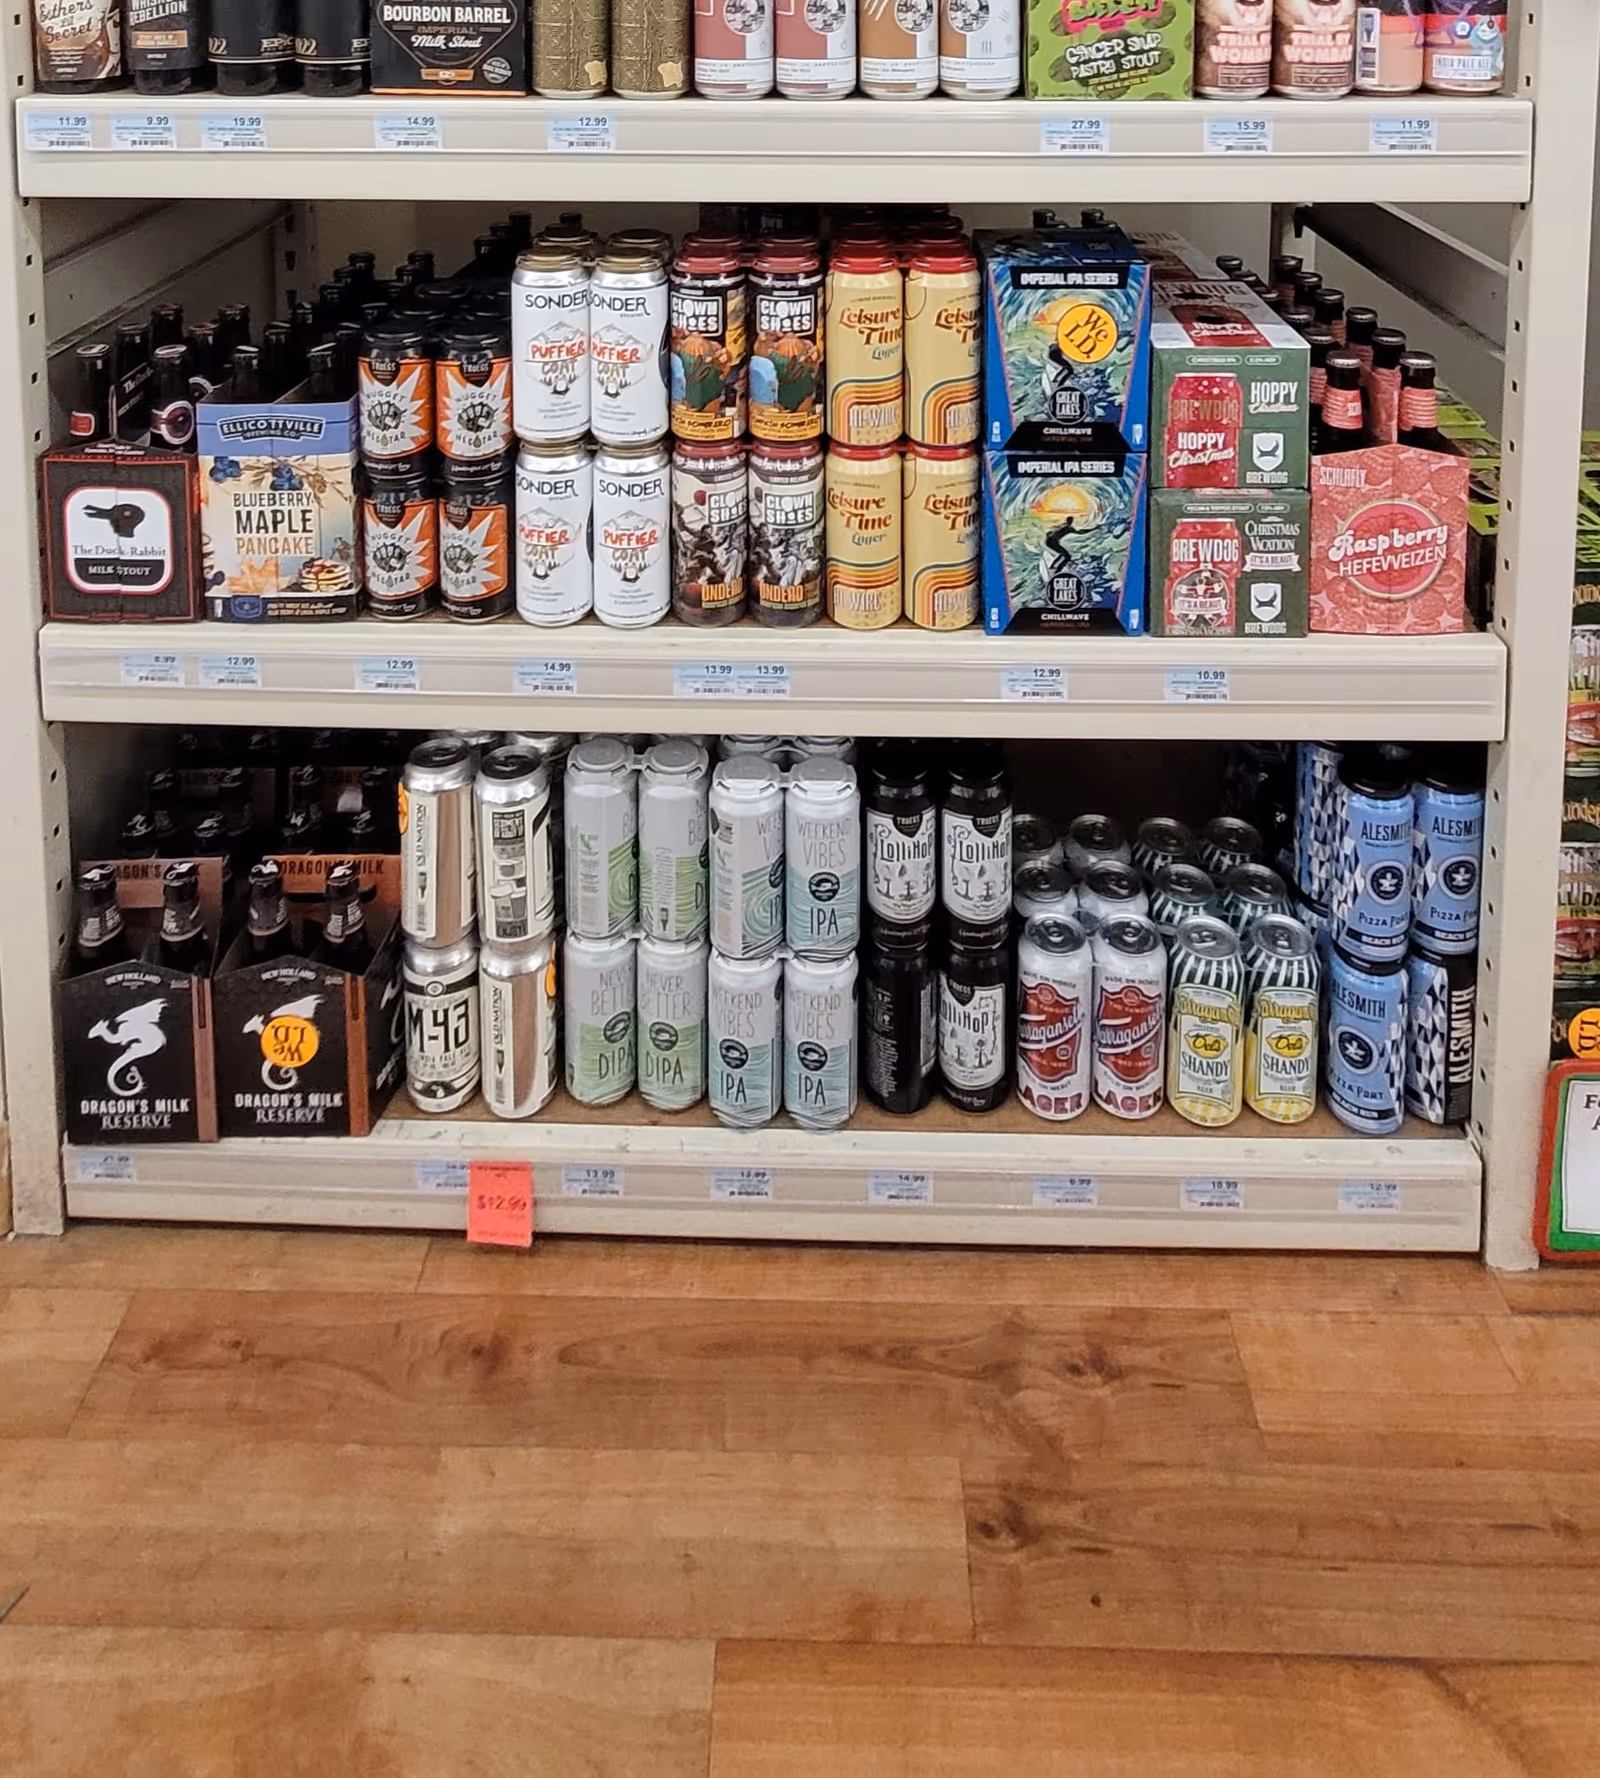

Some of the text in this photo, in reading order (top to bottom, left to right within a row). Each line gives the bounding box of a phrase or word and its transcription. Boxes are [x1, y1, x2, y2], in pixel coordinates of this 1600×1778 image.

[129, 0, 189, 26] REBELLION
[383, 4, 511, 24] BOURBON BARREL
[45, 23, 93, 44] Secret
[417, 24, 477, 35] IMPERIAL
[410, 34, 484, 50] Milk Stout
[1065, 32, 1163, 64] GINGER SNAP
[1071, 50, 1163, 80] PASTRY STOUT
[58, 116, 87, 126] 11.99
[146, 116, 169, 126] 9.99
[233, 117, 261, 126] 19.99
[406, 116, 435, 126] 14.99
[578, 116, 607, 126] 12.99
[1072, 120, 1100, 130] 27.99
[1237, 121, 1266, 130] 15.99
[1401, 120, 1430, 130] 11.99
[1020, 272, 1119, 286] IMPERIAL IPA SERIES
[525, 288, 590, 310] SONDER
[590, 290, 651, 316] SONDER
[672, 297, 718, 317] CLOWN
[760, 297, 811, 317] CLOWN
[672, 316, 718, 332] SHOES
[760, 315, 811, 332] SHOES
[531, 340, 586, 360] PUFFIER
[592, 343, 641, 361] PUFFIER
[541, 359, 578, 375] COAT
[596, 363, 630, 376] COAT
[365, 390, 407, 403] NUGGET
[455, 390, 498, 404] NUGGET
[1055, 390, 1080, 404] GREAT
[1250, 381, 1299, 405] HOPPY
[1055, 403, 1081, 416] LAKES
[1173, 399, 1239, 421] BREWDOG
[222, 418, 321, 434] ELLICOTTVILLE
[1043, 427, 1092, 436] CHILLWAVE
[1178, 431, 1226, 450] HOPPY
[1168, 447, 1236, 469] Christmas
[1017, 461, 1115, 474] IMPERIAL IPA SERIES
[1246, 472, 1288, 484] BREWDOG
[1319, 466, 1367, 487] SCHLAFLY
[599, 478, 665, 501] SONDER
[233, 491, 313, 508] BLUEBERRY
[766, 493, 813, 510] CLOWN
[828, 487, 887, 512] Leisure
[235, 508, 314, 534] MAPLE
[766, 508, 813, 524] SHOES
[841, 510, 892, 531] Time
[519, 526, 570, 546] PUFFIER
[1244, 520, 1301, 537] CHRISTMAS
[236, 536, 314, 556] PANCAKE
[370, 531, 411, 545] NUGGET
[603, 528, 658, 547] PUFFIER
[1250, 536, 1296, 552] VACATION
[1328, 523, 1449, 562] Raspberry
[73, 544, 167, 557] The Duck-Rabbit
[524, 547, 558, 560] COAT
[612, 548, 648, 561] COAT
[1172, 538, 1239, 563] BREWDOG
[1339, 544, 1448, 577] HEFEWEIZEN
[88, 565, 151, 577] MILK STOUT
[701, 579, 744, 601] UNDEAD
[760, 582, 804, 603] UNDEAD
[1053, 577, 1078, 591] GREAT
[1053, 589, 1078, 602] LAKES
[1041, 613, 1090, 621] CHILLWAVE
[1244, 622, 1287, 634] BREWDOG
[227, 656, 255, 666] 12.99
[386, 659, 413, 670] 12.99
[543, 662, 572, 672] 14.99
[704, 665, 732, 674] 13.99
[757, 665, 785, 674] 13.99
[1033, 668, 1061, 678] 12.99
[1197, 671, 1225, 680] 10.99
[802, 840, 847, 870] VIBES
[351, 860, 385, 876] MILK
[809, 907, 839, 937] IPA
[1358, 911, 1389, 927] PIZZA
[1430, 906, 1461, 921] PIZZA
[123, 972, 162, 986] HOLLAND
[493, 986, 501, 1025] NATION
[1331, 985, 1387, 1020] ALESMITH
[408, 998, 471, 1054] M-43
[1449, 985, 1477, 1085] ALESMITH
[1181, 1052, 1229, 1077] SHANDY
[1262, 1053, 1311, 1075] SHANDY
[720, 1071, 748, 1104] IPA
[798, 1072, 827, 1106] IPA
[80, 1098, 190, 1115] DRAGON'S MILK
[235, 1092, 344, 1109] DRAGON'S MILK
[101, 1113, 172, 1130] RESERVE
[255, 1106, 325, 1123] RESERVE
[586, 1169, 616, 1179] 13.99
